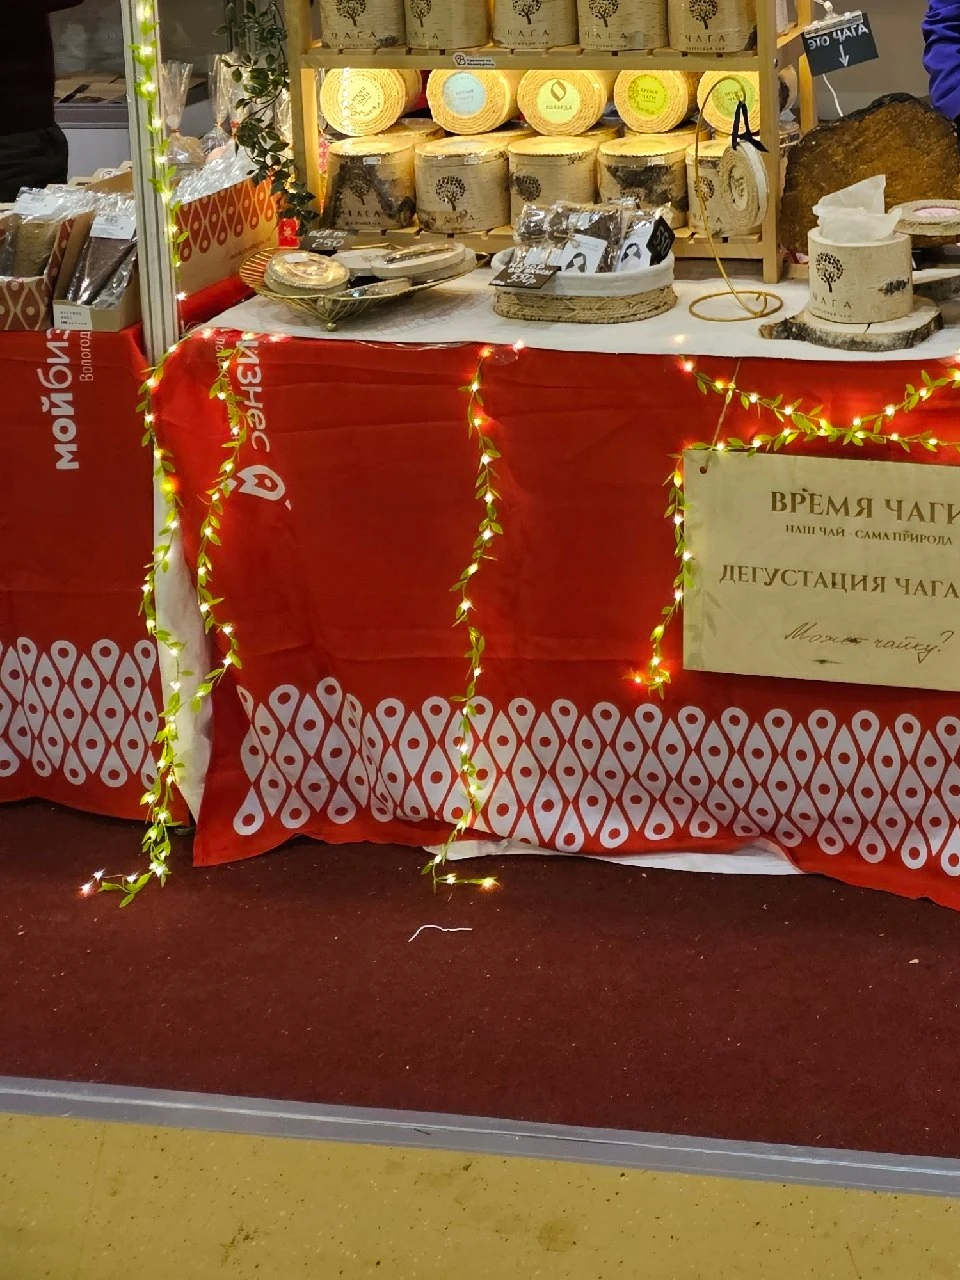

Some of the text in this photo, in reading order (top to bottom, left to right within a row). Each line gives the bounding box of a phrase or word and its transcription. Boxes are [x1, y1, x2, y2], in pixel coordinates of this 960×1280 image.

[684, 34, 726, 42] ЧАГА
[807, 23, 870, 50] ЭТО ЧАГА
[312, 238, 345, 248] 250
[40, 392, 80, 471] мой
[770, 491, 874, 519] ВРЕМЯ
[785, 524, 953, 546] НАШ ЧАЙ САМА ПРИРОДА
[719, 564, 887, 594] ДЕГУСТАЦИЯ
[895, 576, 960, 599] ЧАГА
